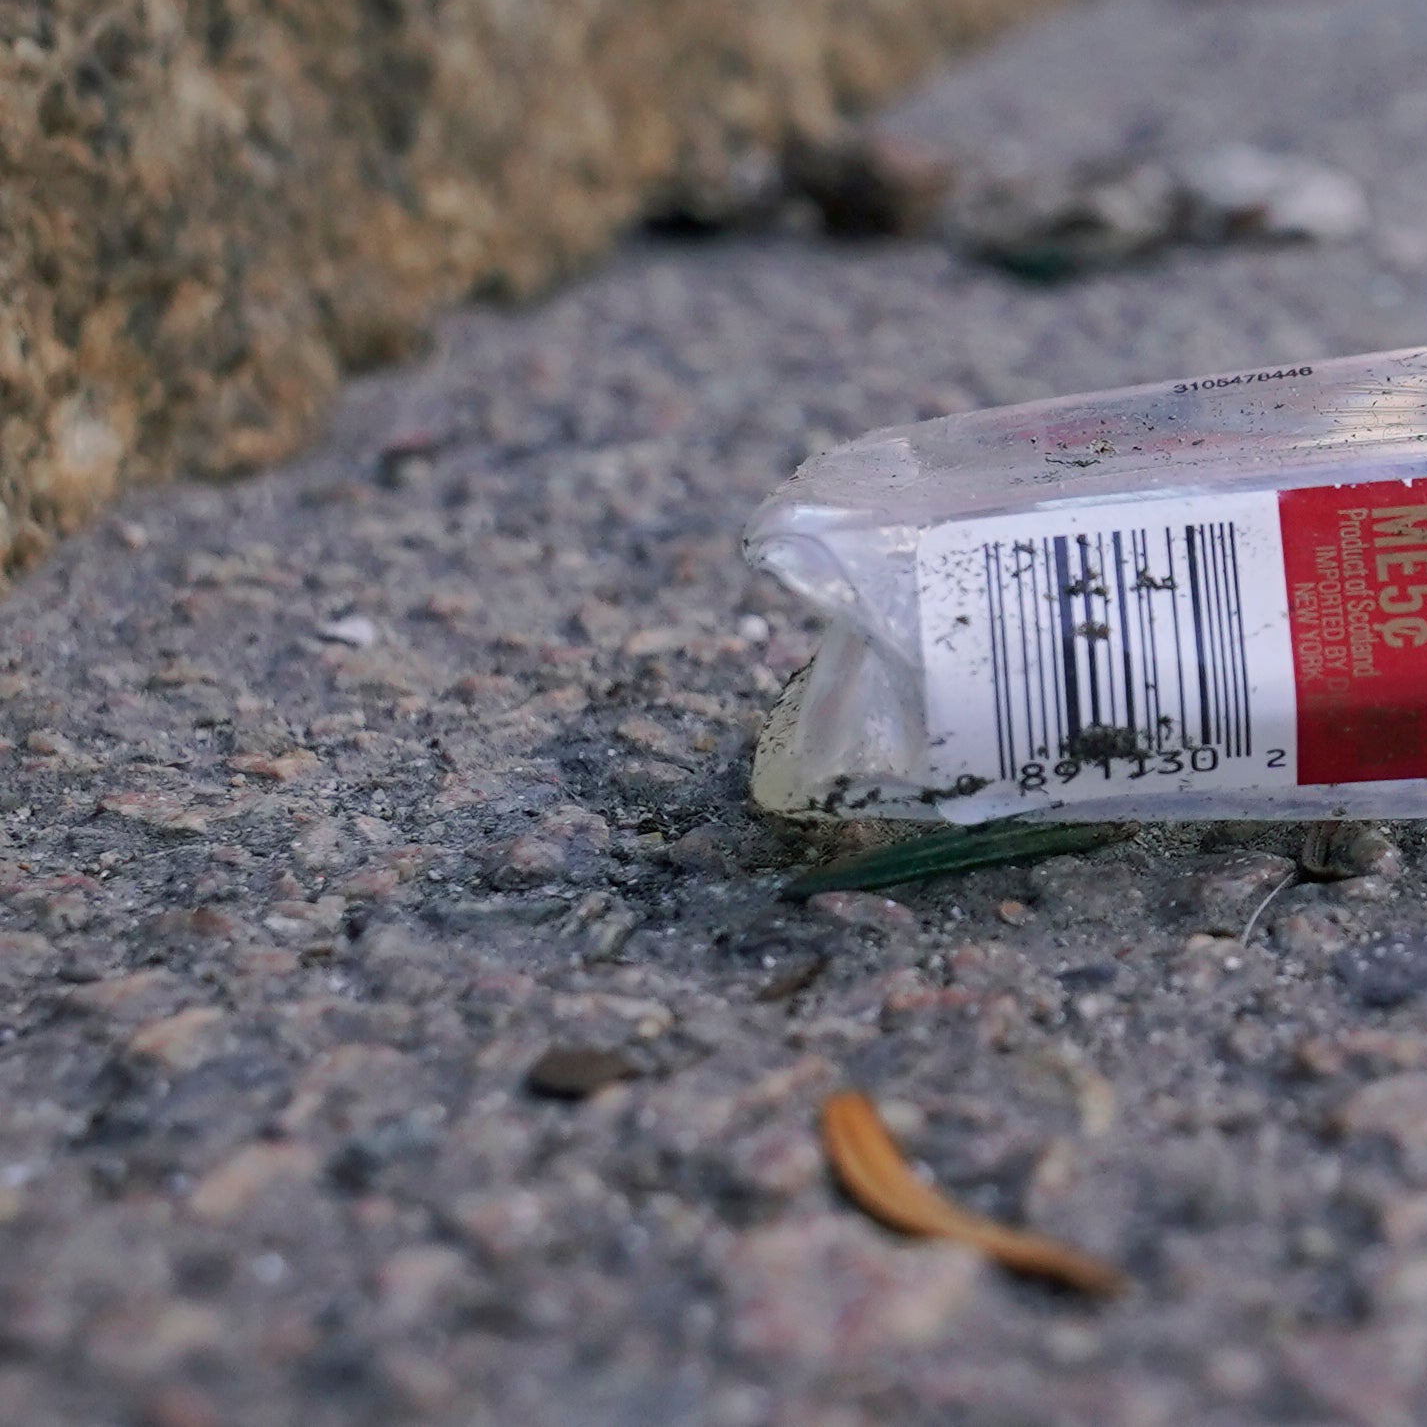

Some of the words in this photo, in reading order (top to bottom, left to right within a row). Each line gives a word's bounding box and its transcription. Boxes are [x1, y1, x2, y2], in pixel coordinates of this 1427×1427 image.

[1337, 508, 1369, 576] Product
[1293, 583, 1321, 624] NEW
[1314, 545, 1343, 640] IMPORTED
[1343, 579, 1373, 596] of
[1325, 646, 1347, 670] BY
[1350, 600, 1382, 677] Scotland
[1266, 748, 1287, 769] 2
